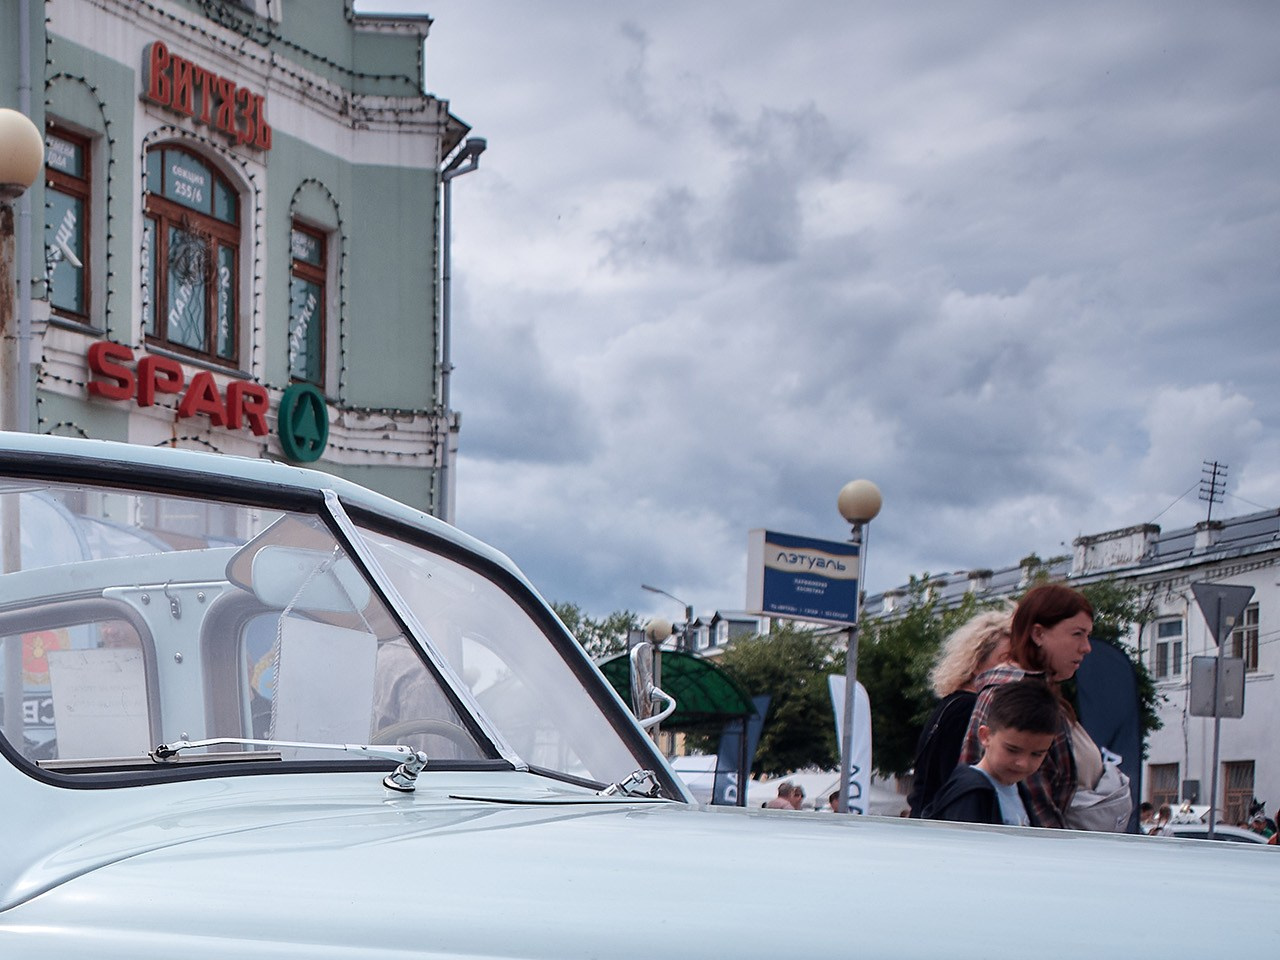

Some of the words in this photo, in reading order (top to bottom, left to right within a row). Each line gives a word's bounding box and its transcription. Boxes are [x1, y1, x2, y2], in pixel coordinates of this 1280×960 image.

[149, 40, 272, 151] ВИТЯЗЬ
[172, 164, 206, 185] секция
[174, 180, 203, 203] 255/6
[88, 341, 269, 437] SPAR
